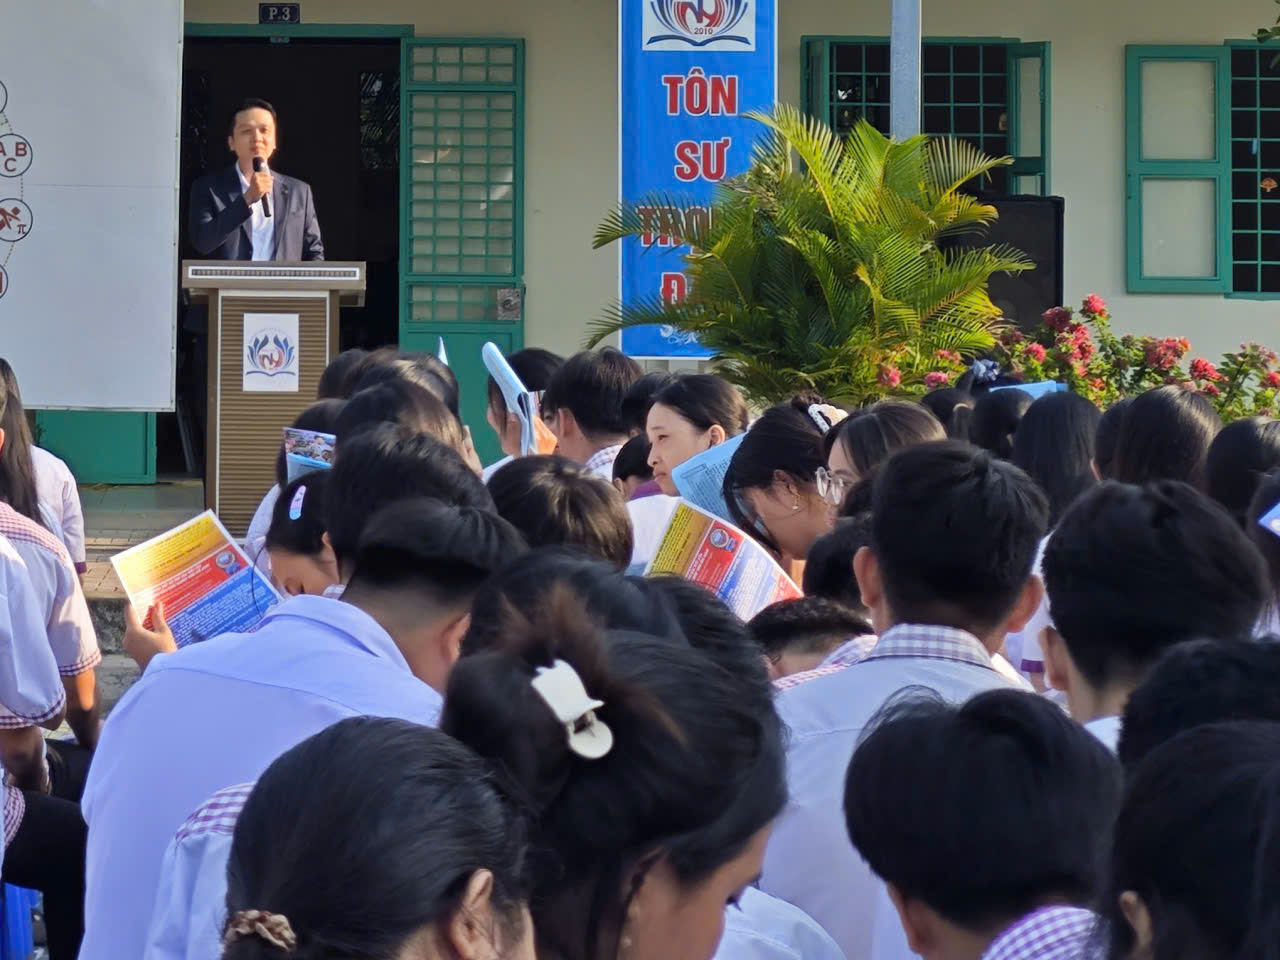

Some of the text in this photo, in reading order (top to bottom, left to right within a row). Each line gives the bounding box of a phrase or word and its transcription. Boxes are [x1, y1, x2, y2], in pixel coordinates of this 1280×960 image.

[268, 7, 291, 21] P.3
[694, 27, 713, 35] 2010
[661, 67, 739, 116] TÔN
[15, 141, 27, 157] B
[4, 158, 17, 172] C
[674, 137, 731, 182] SƯ
